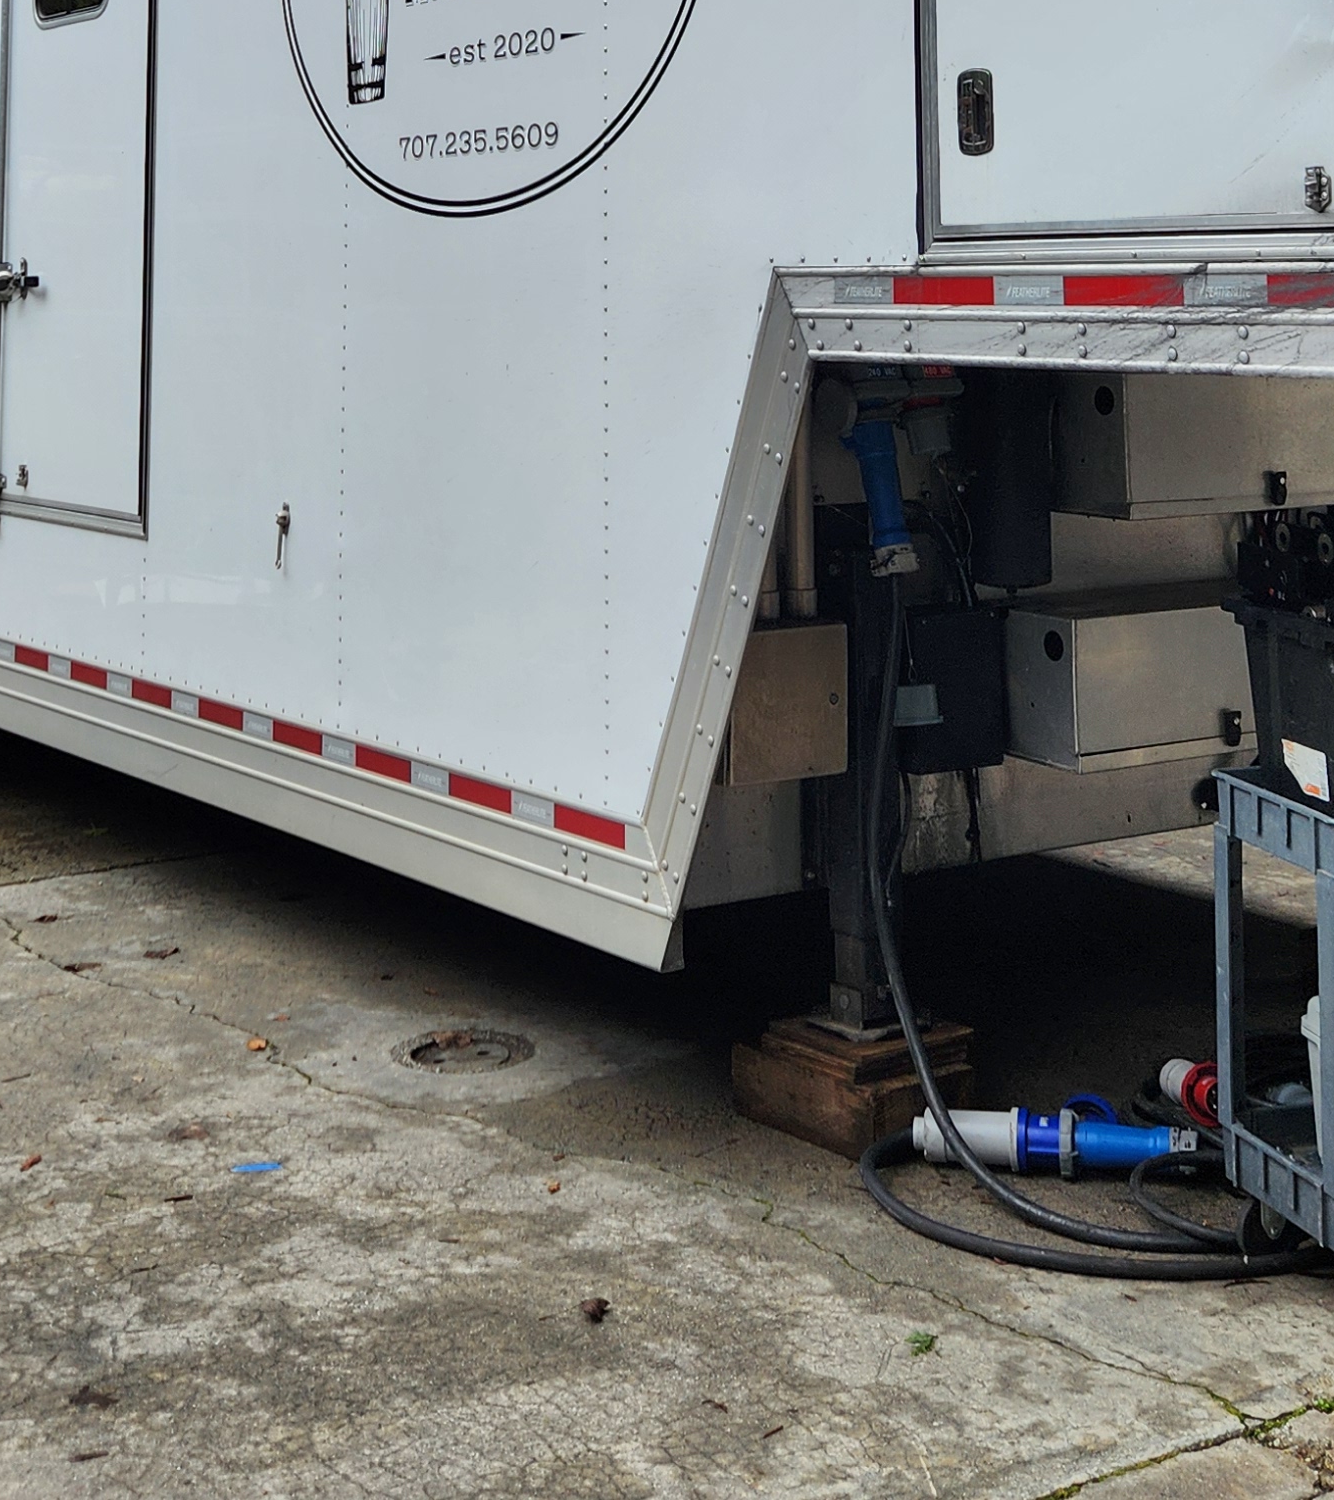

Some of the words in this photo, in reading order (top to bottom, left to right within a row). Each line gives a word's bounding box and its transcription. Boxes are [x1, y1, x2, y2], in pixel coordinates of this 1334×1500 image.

[449, 37, 486, 66] est
[493, 27, 556, 60] 2020
[399, 121, 559, 161] 707.235.5609
